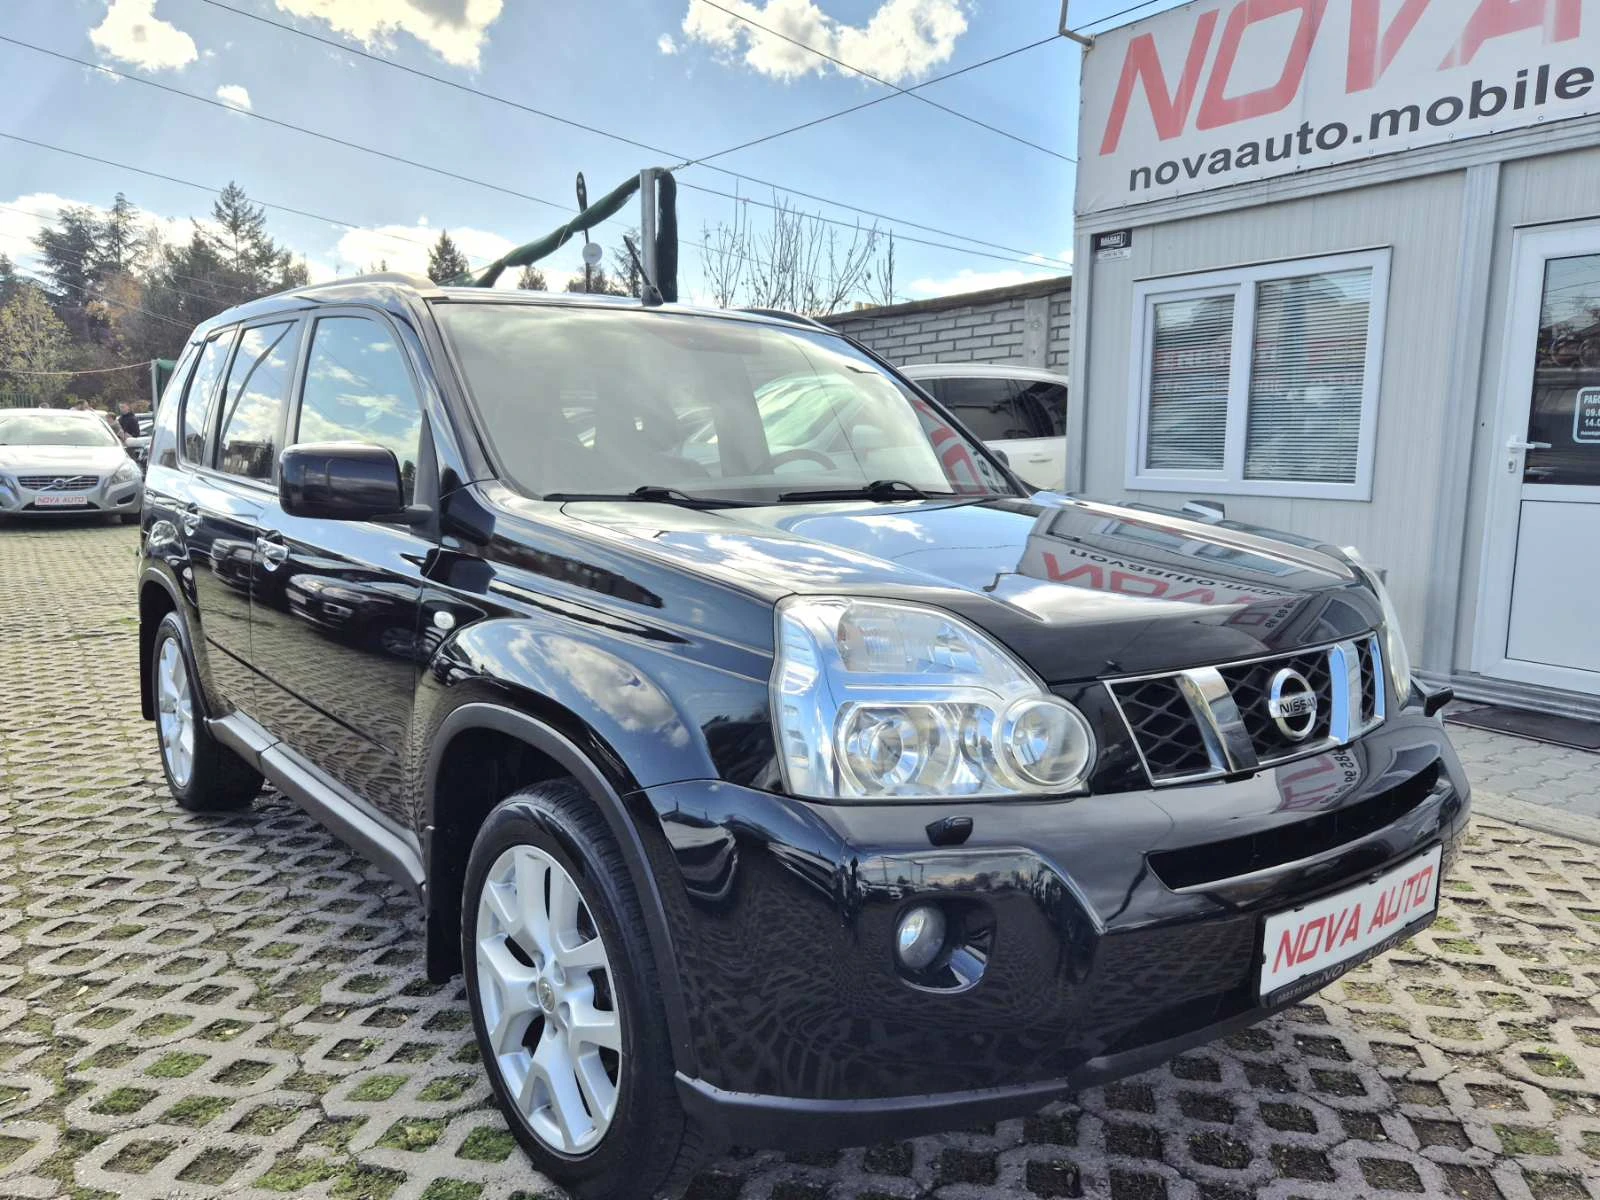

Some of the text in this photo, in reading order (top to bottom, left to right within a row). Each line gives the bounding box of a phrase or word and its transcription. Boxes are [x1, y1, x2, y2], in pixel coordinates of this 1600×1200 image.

[1129, 63, 1595, 191] novaauto.mobile
[1272, 865, 1433, 974] NOVA AUTO
